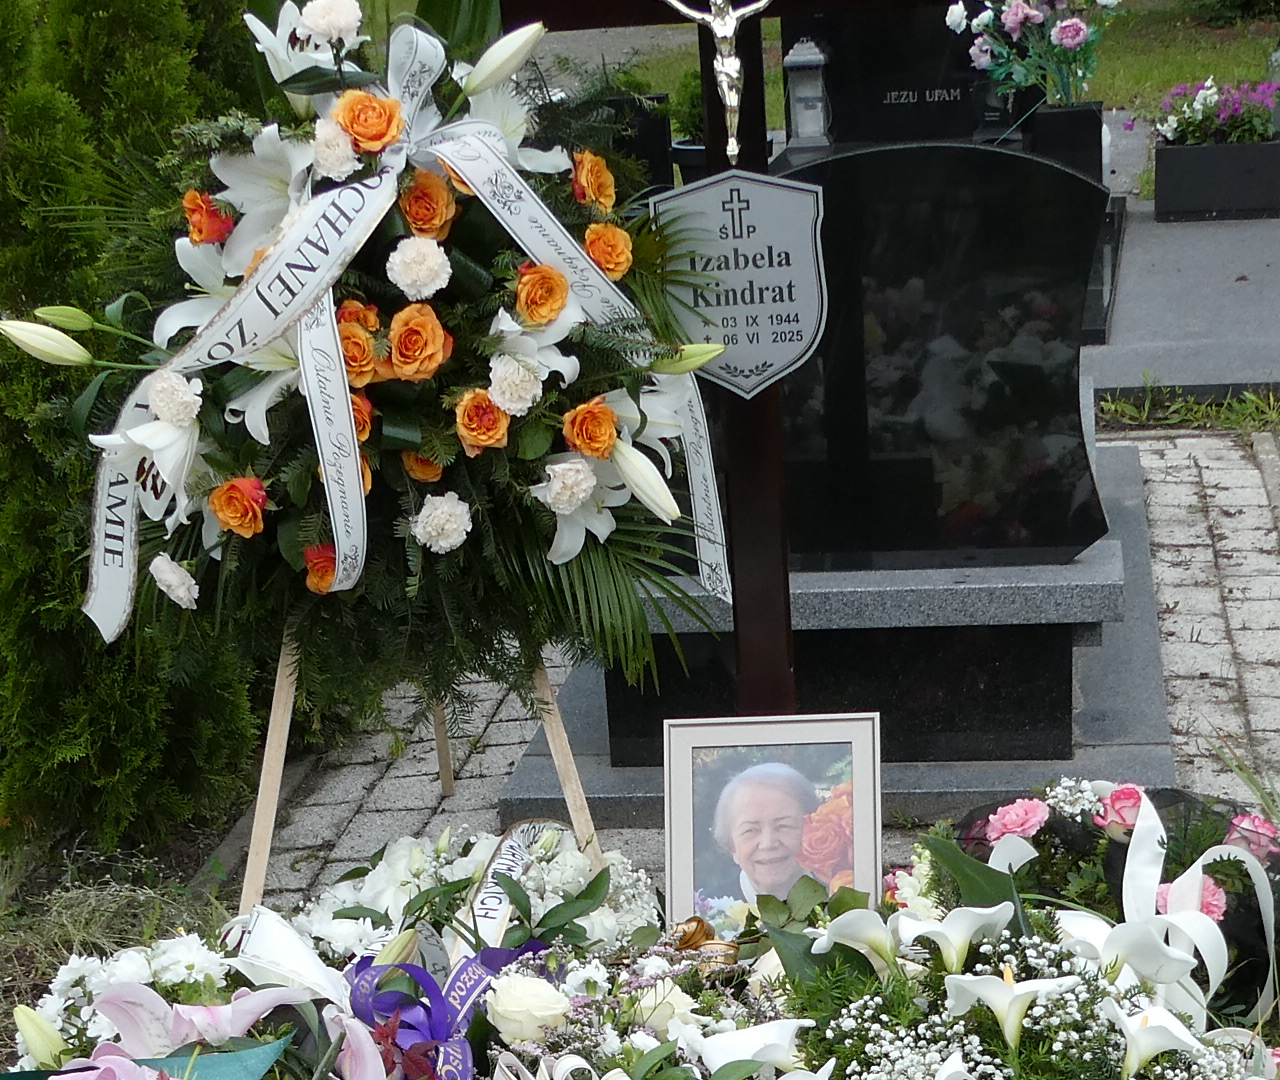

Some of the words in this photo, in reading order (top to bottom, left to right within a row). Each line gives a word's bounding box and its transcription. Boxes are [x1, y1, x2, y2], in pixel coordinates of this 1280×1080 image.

[746, 224, 757, 239] P
[686, 245, 793, 273] Izabela
[692, 279, 797, 309] Kindrat
[721, 316, 738, 329] 03
[745, 315, 760, 328] IX
[767, 312, 801, 326] 1944
[722, 333, 739, 346] 06
[745, 332, 760, 345] VI
[771, 330, 804, 344] 2025
[103, 468, 130, 569] AMIE
